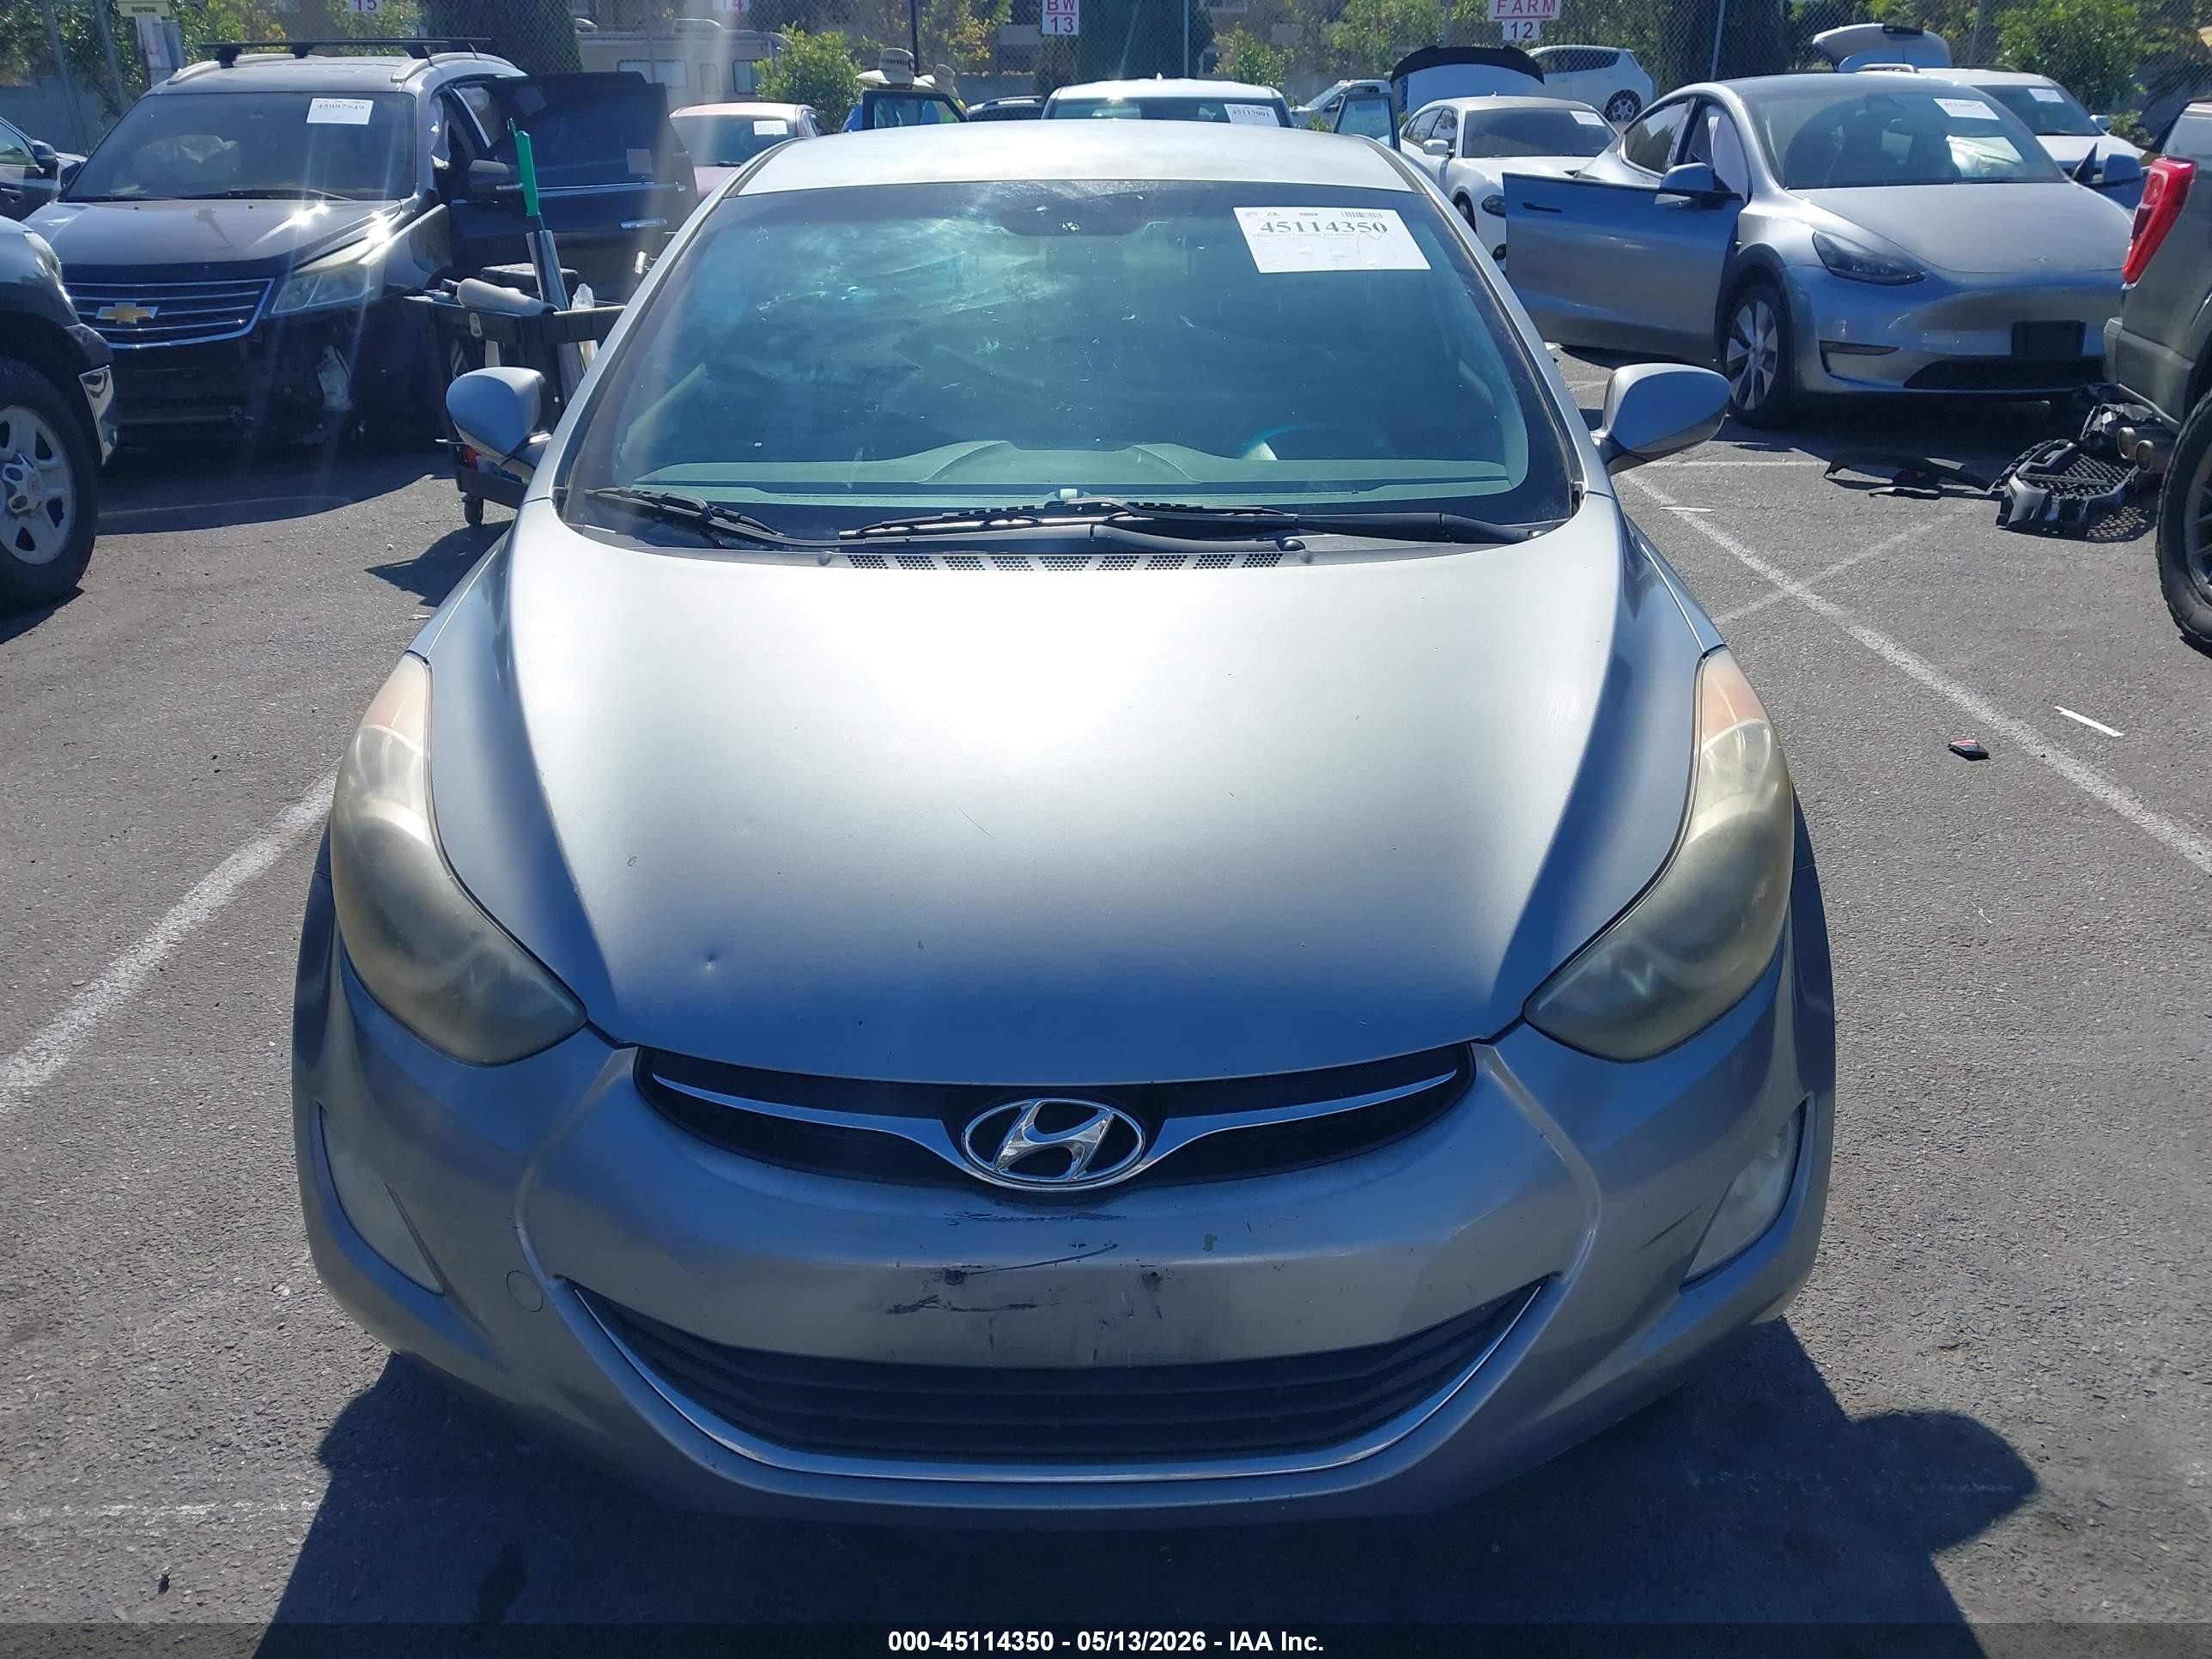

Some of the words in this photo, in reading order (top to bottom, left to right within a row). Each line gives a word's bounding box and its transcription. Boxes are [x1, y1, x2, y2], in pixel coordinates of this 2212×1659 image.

[354, 0, 377, 10] 15
[1047, 0, 1074, 10] BW
[1497, 0, 1555, 14] FARM
[1050, 16, 1073, 33] 13
[1511, 21, 1533, 39] 12
[1260, 221, 1388, 234] 45114350
